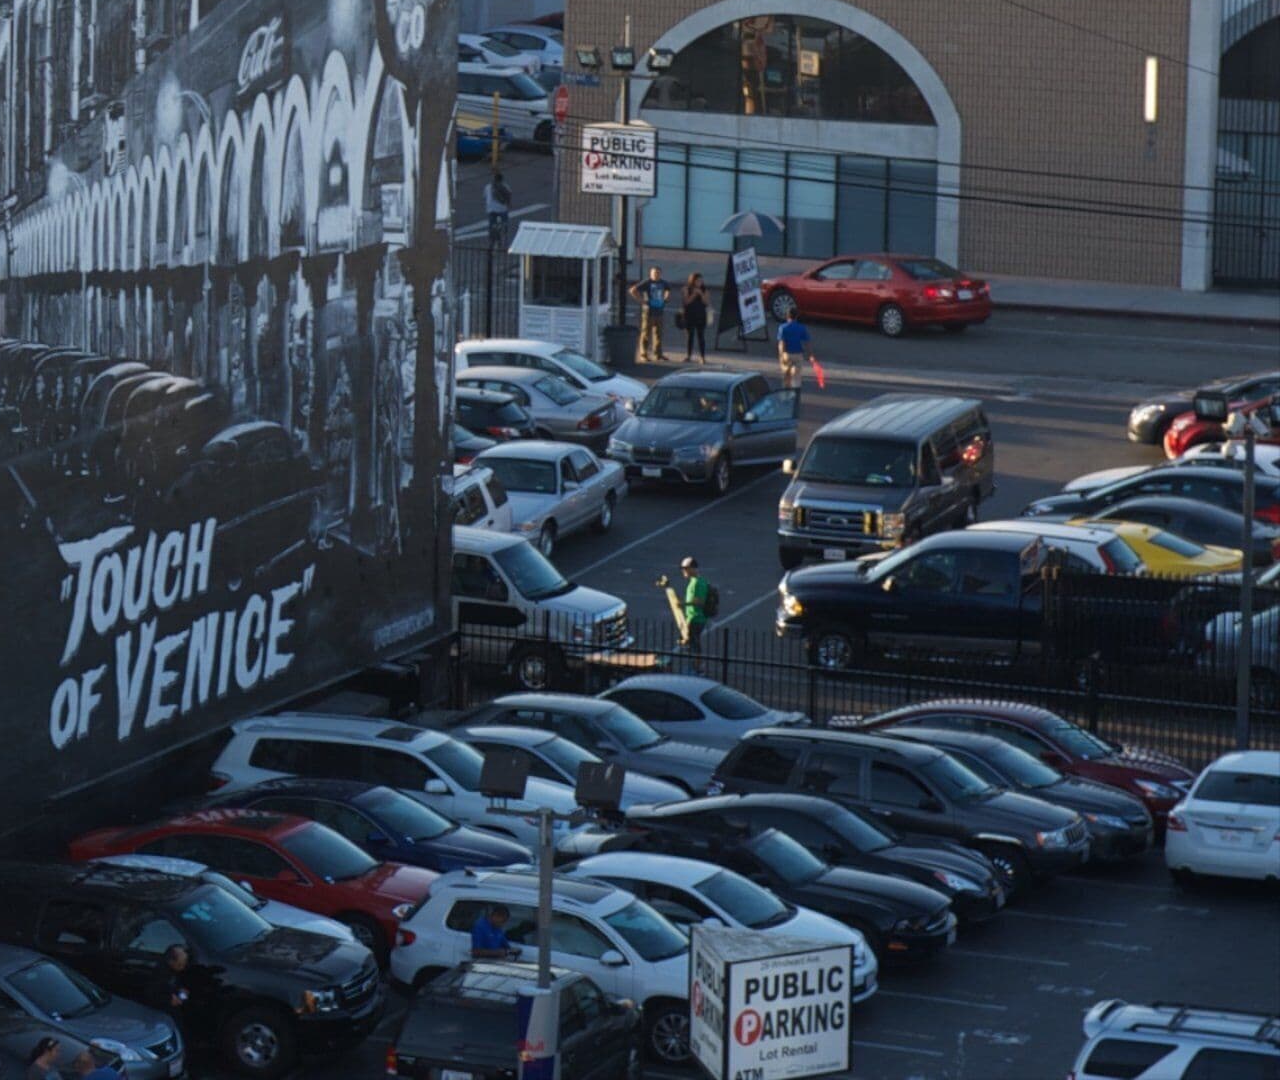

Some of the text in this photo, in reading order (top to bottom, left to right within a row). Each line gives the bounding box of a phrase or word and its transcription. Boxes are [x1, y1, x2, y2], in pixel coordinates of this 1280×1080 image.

[590, 136, 647, 153] PUBLIC
[585, 151, 652, 171] PARKING
[49, 663, 108, 750] OF
[744, 966, 844, 1006] PUBLIC
[734, 1000, 845, 1047] PARKING
[758, 1042, 818, 1062] Lot Rental
